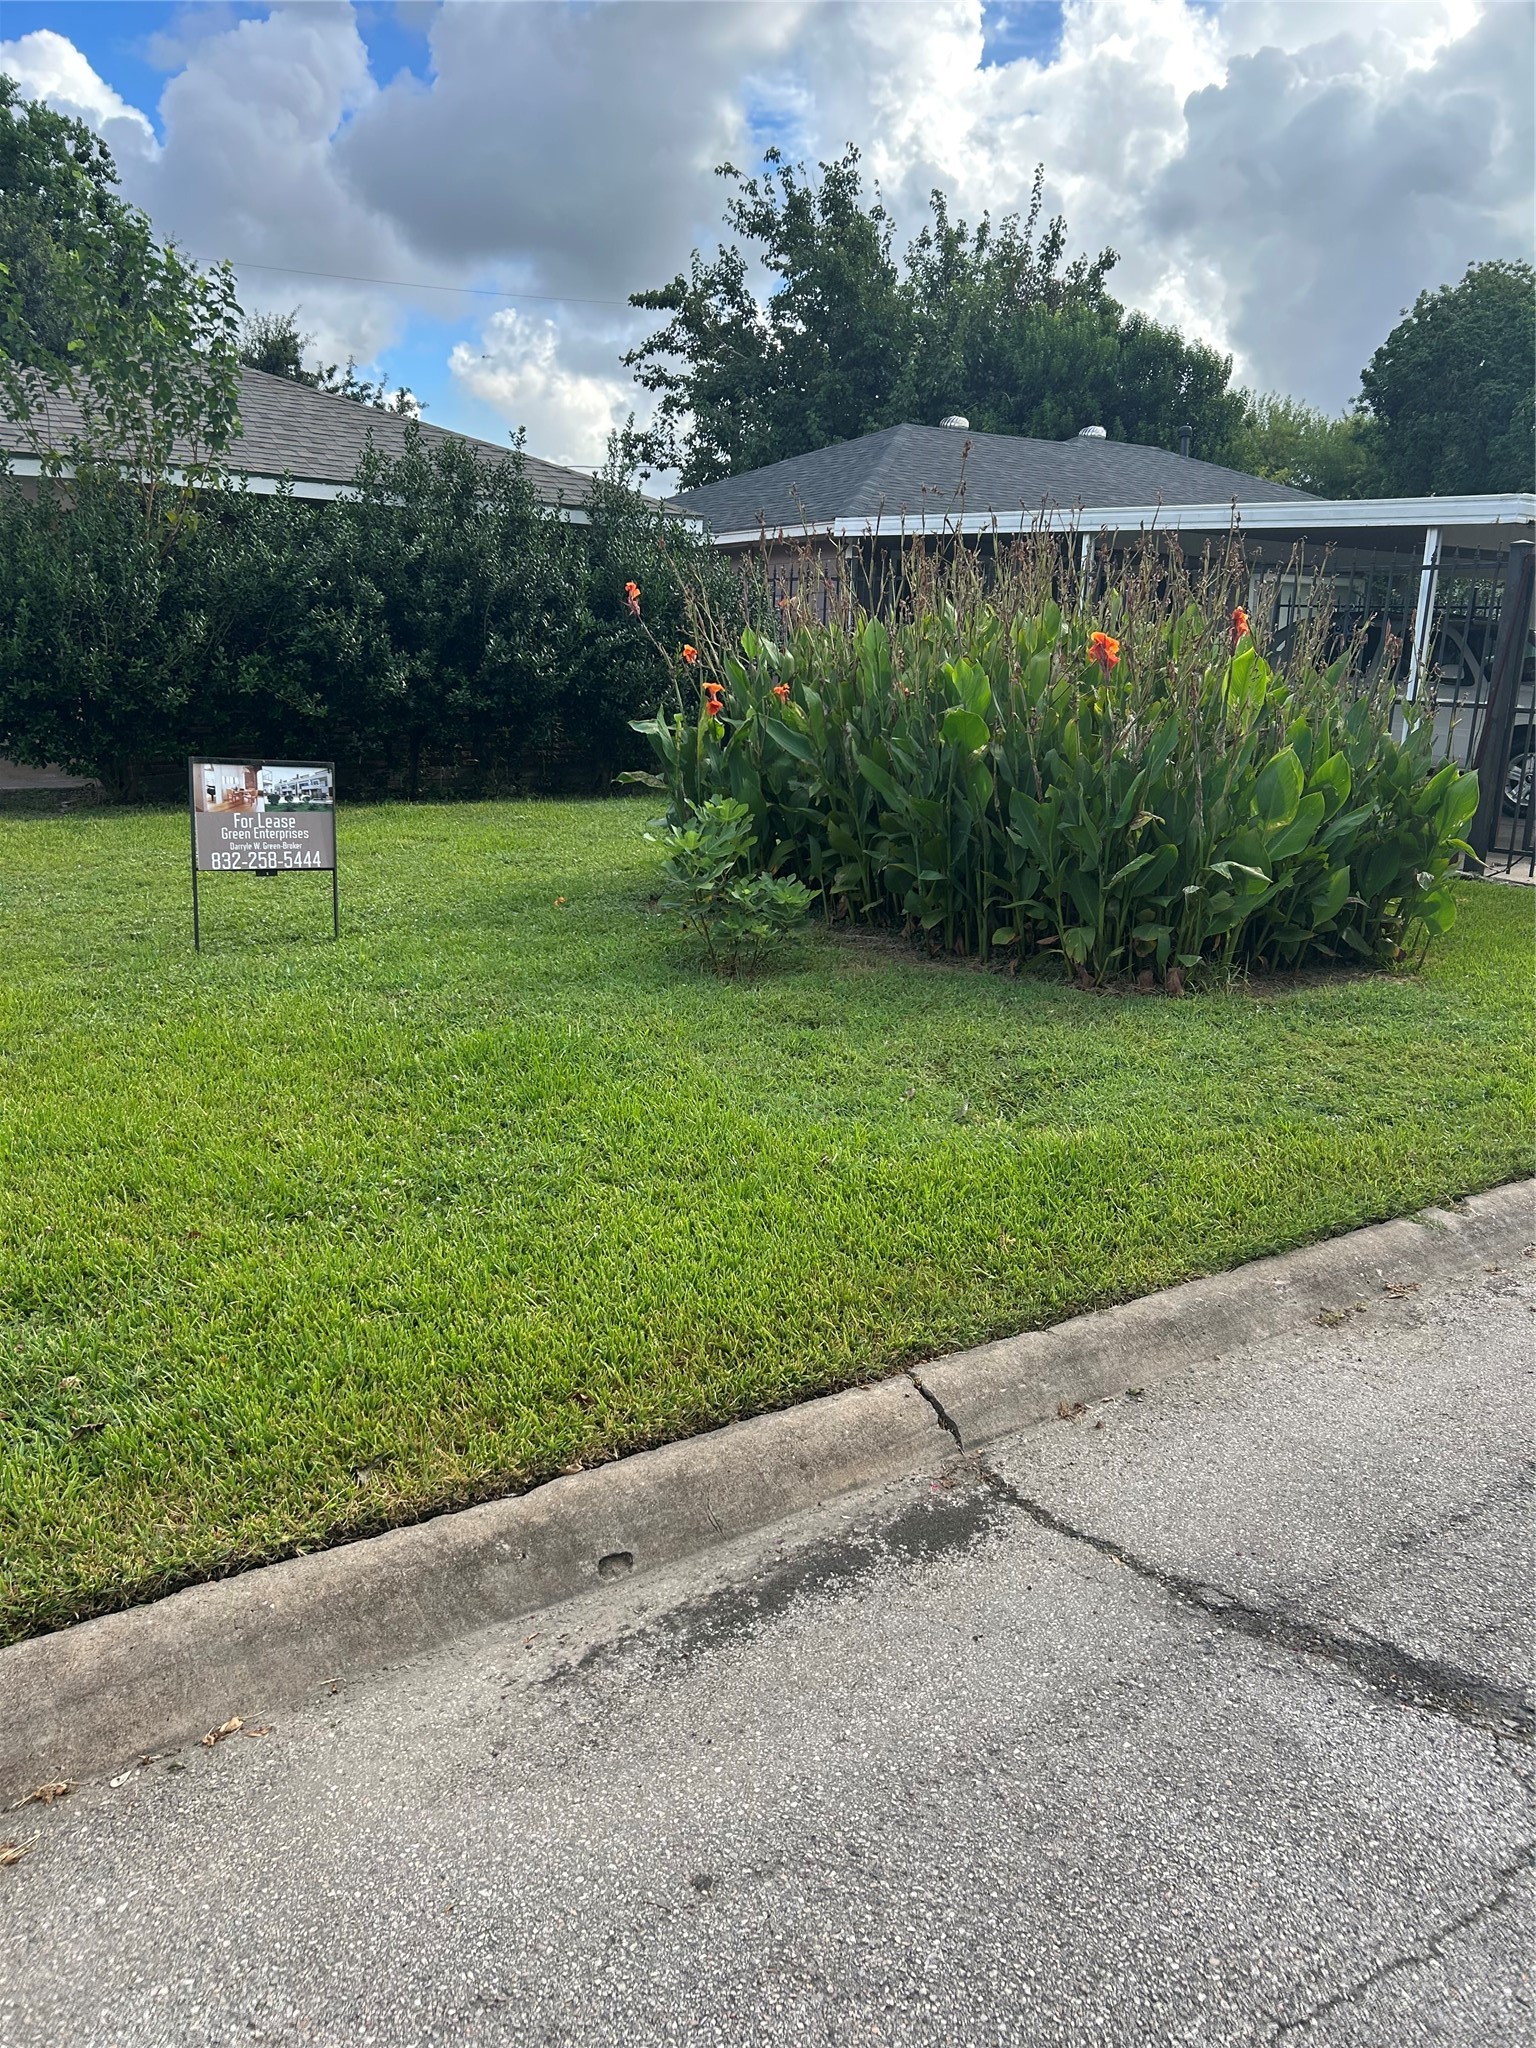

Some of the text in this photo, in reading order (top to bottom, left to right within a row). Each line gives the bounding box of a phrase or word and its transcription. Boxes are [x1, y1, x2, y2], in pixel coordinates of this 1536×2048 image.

[233, 812, 296, 829] For Lease
[221, 827, 309, 841] Green Enterprises
[211, 851, 321, 869] 832-258-5444
